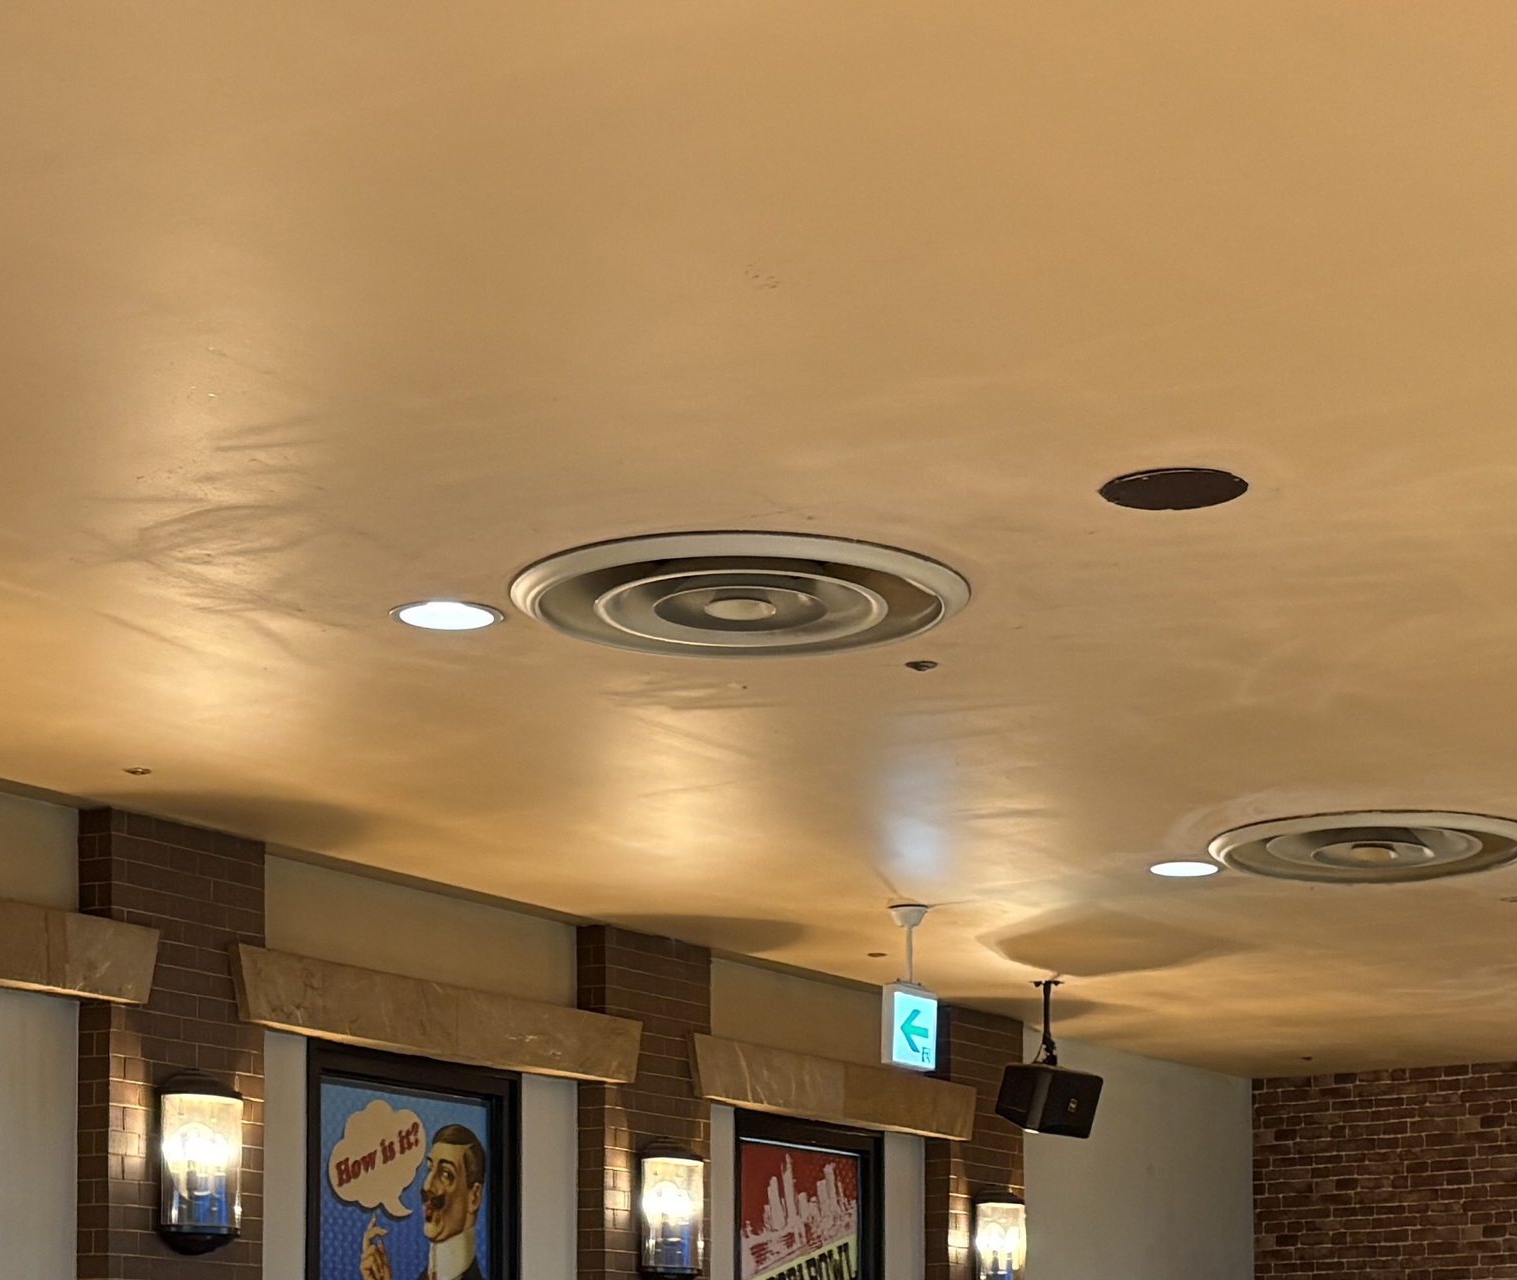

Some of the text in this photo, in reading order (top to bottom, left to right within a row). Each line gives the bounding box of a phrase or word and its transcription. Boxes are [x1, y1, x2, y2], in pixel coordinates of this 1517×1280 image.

[336, 1122, 420, 1188] How is it?
